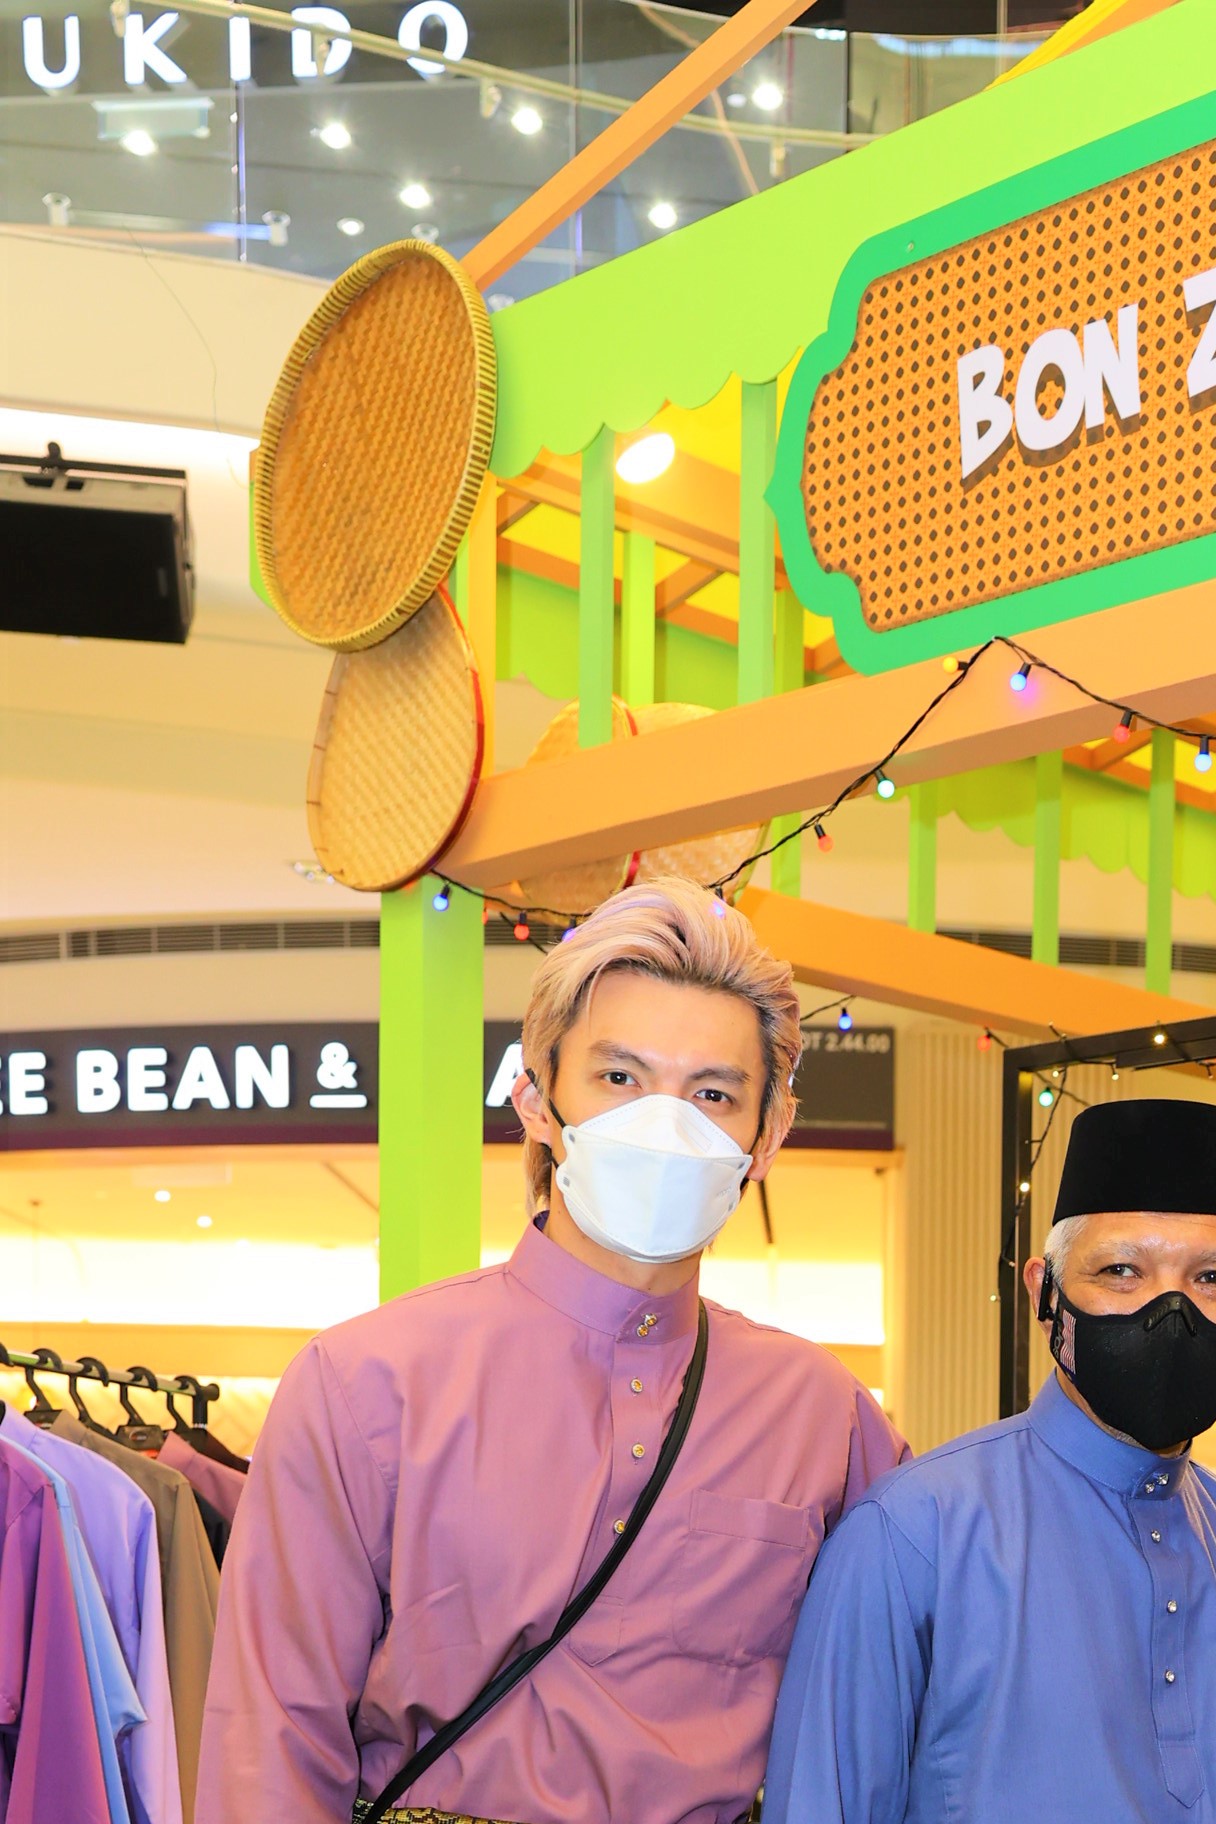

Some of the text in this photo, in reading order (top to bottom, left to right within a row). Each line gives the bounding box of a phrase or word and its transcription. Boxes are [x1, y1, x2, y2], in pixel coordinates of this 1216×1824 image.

[957, 303, 1142, 480] BON
[76, 1044, 289, 1113] BEAN
[311, 1042, 366, 1107] &
